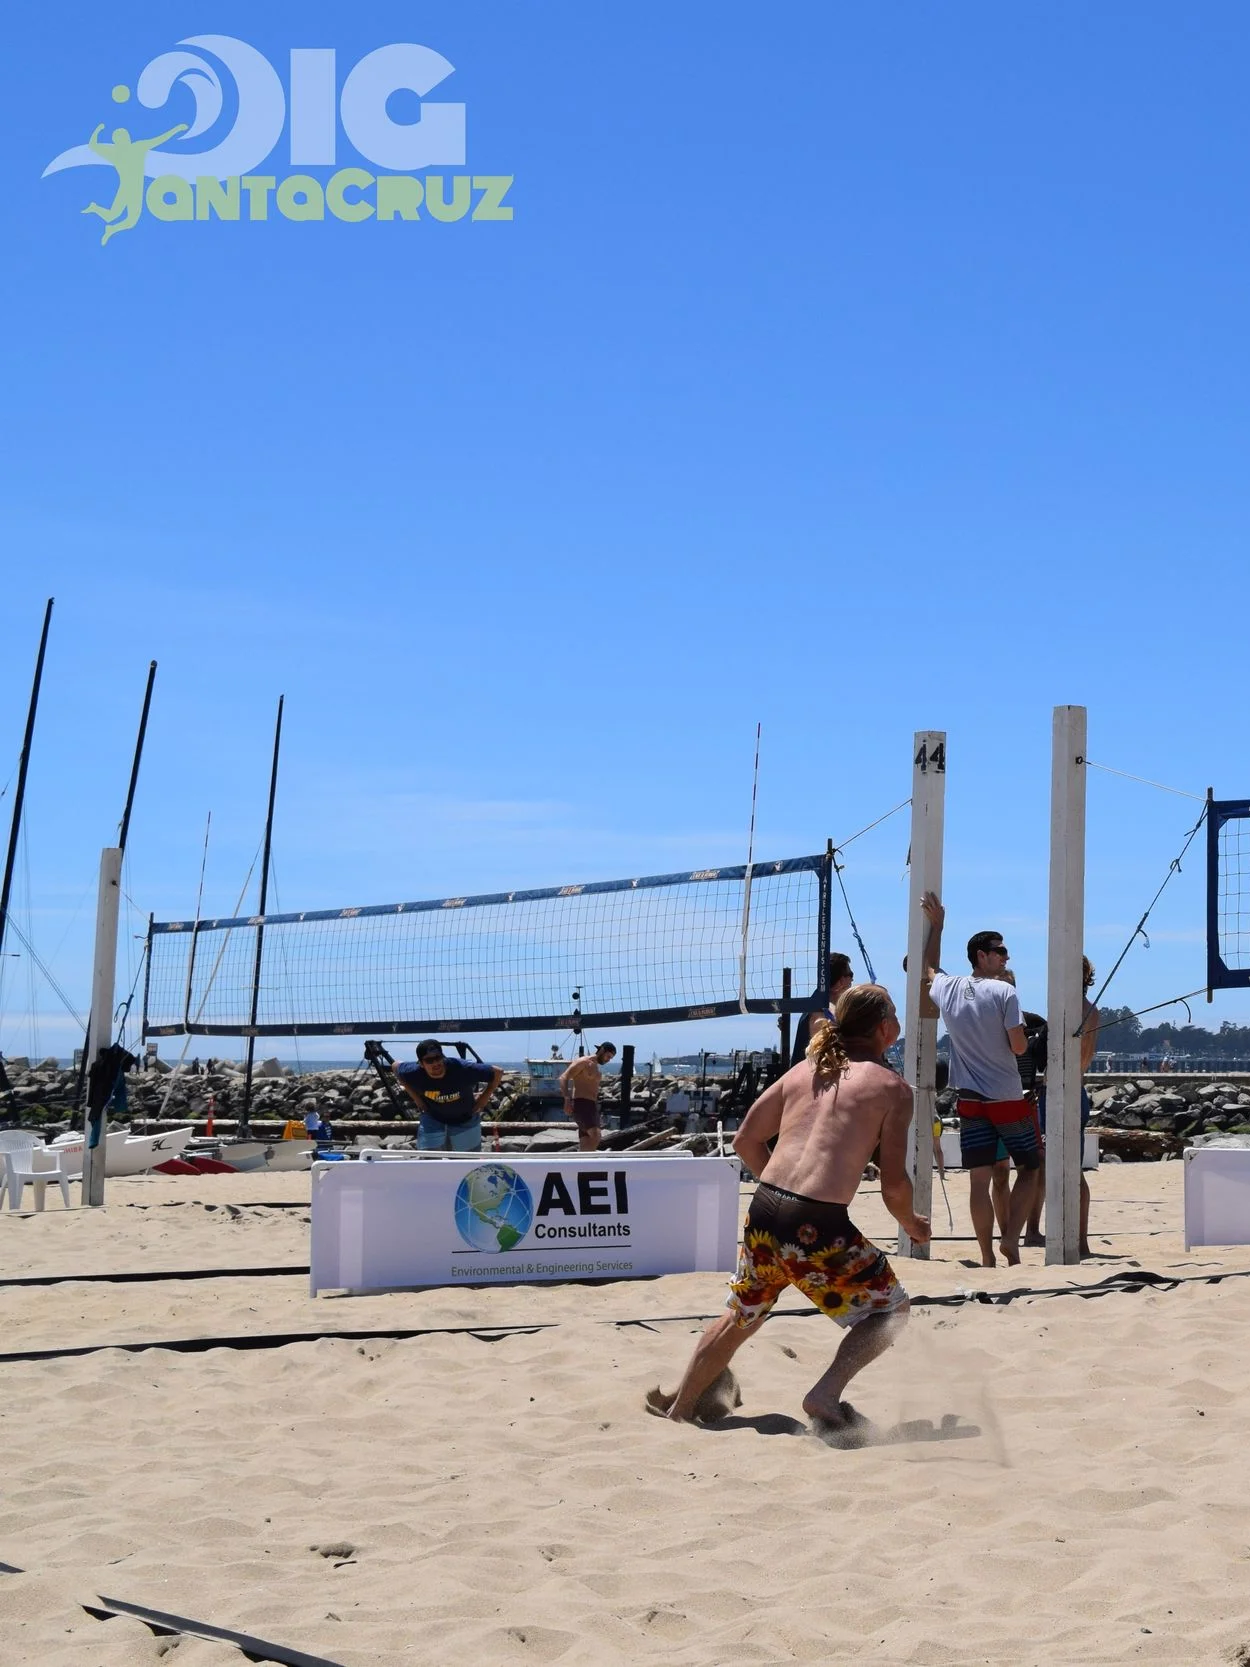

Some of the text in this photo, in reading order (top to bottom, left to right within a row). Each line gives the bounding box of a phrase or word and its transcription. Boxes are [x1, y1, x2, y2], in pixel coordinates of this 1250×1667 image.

[536, 1171, 629, 1216] AEI
[535, 1222, 631, 1239] Consultants
[451, 1260, 633, 1277] Environmental & Engineering Services
